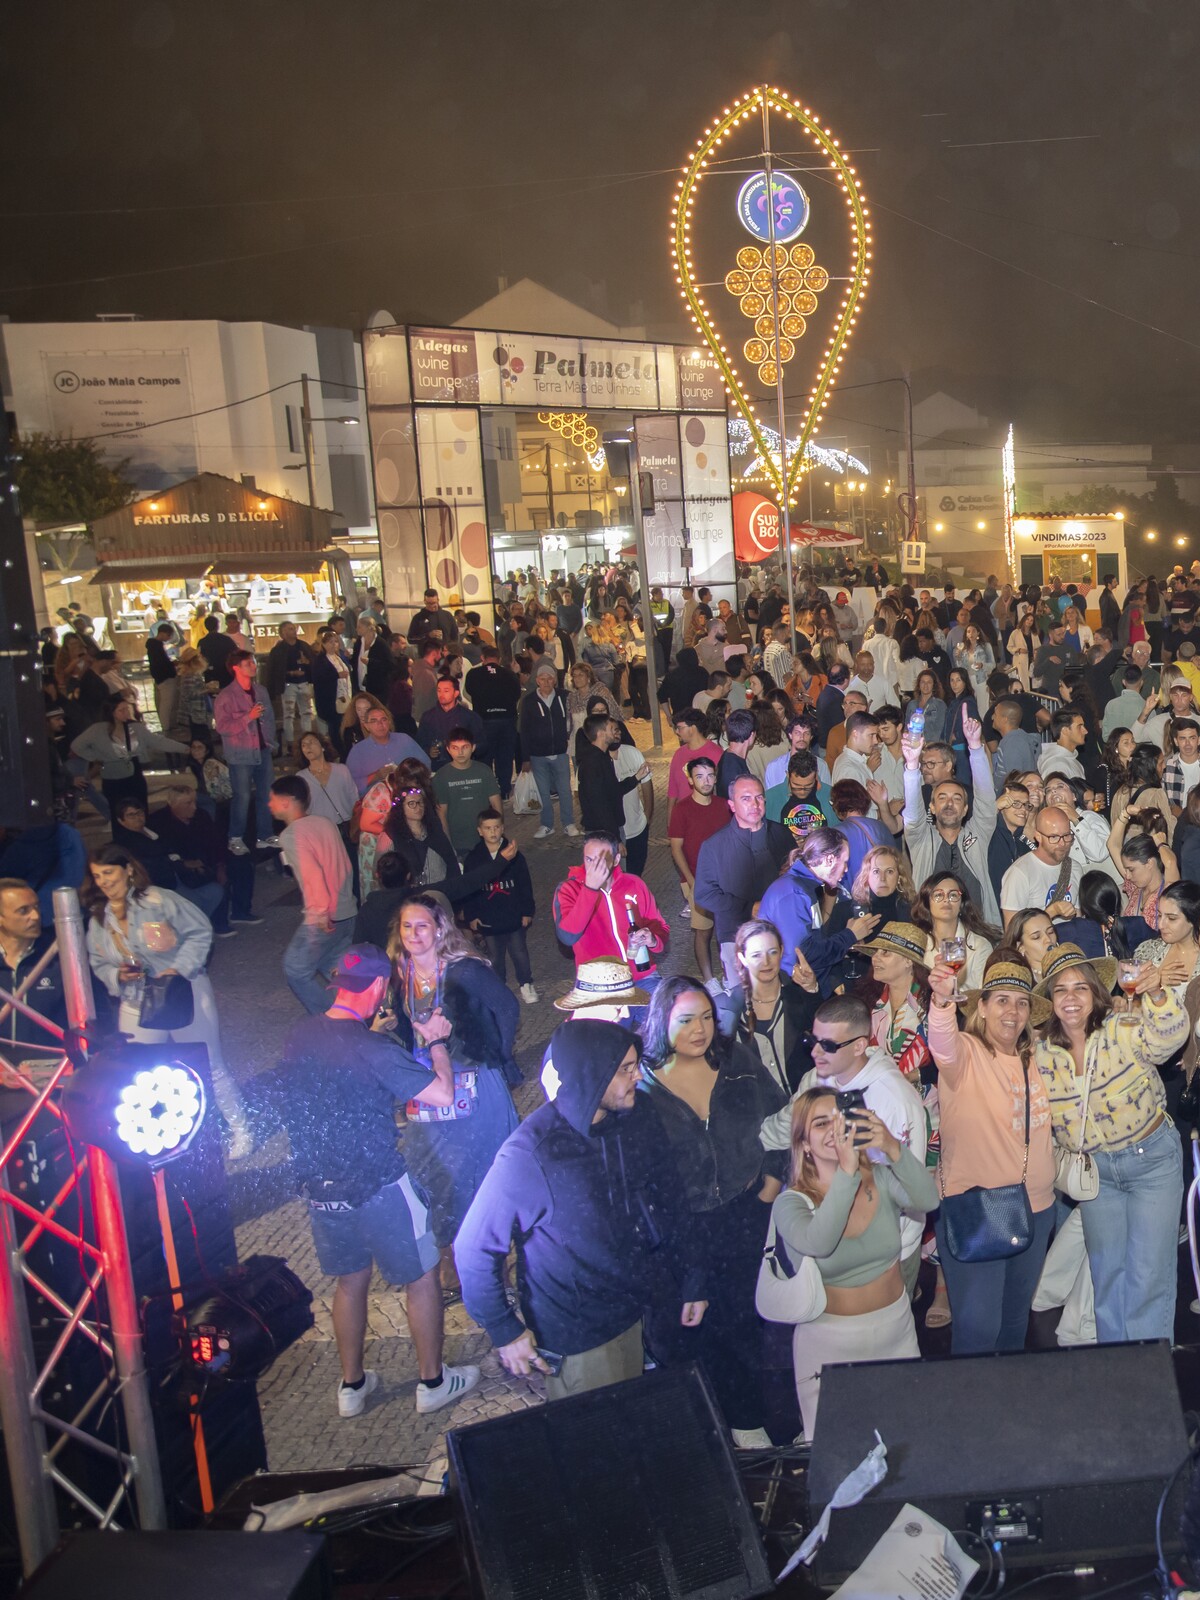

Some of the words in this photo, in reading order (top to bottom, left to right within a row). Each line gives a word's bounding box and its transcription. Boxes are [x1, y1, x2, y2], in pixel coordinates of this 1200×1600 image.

[415, 339, 469, 355] Adegas
[417, 356, 449, 370] wine
[532, 350, 660, 381] Palmela
[59, 377, 75, 387] JC
[81, 376, 106, 387] João
[138, 376, 182, 387] Campos
[418, 373, 462, 393] lounge
[681, 371, 705, 383] wine
[533, 378, 562, 393] Terra
[591, 381, 604, 394] de
[606, 382, 641, 396] Vinhos
[681, 386, 714, 400] lounge
[640, 455, 677, 466] Palmela
[133, 513, 210, 526] FARTURAS
[689, 510, 714, 523] wine
[690, 526, 724, 543] lounge
[783, 813, 826, 825] BARCELONA
[311, 1200, 351, 1212] FILA
